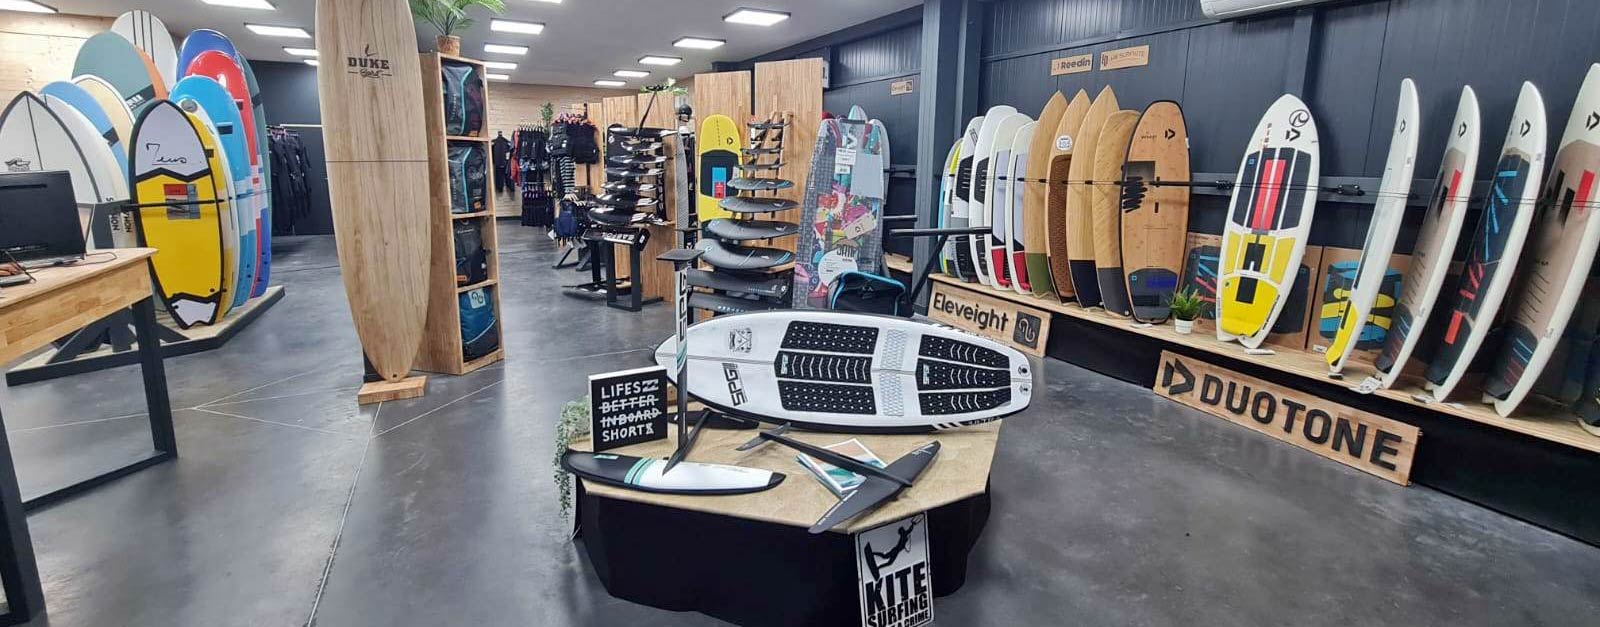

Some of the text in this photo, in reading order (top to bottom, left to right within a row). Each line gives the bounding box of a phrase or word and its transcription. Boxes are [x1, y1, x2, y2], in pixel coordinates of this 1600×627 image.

[348, 57, 389, 69] DUKE
[1061, 57, 1091, 69] Reedin
[933, 292, 1009, 330] Eleveight
[601, 381, 641, 399] LIFES
[600, 395, 657, 414] BETTER
[1200, 373, 1402, 471] DUOTONE
[865, 561, 927, 616] KITE
[867, 593, 929, 627] SURFING
[904, 609, 928, 627] CRIME
